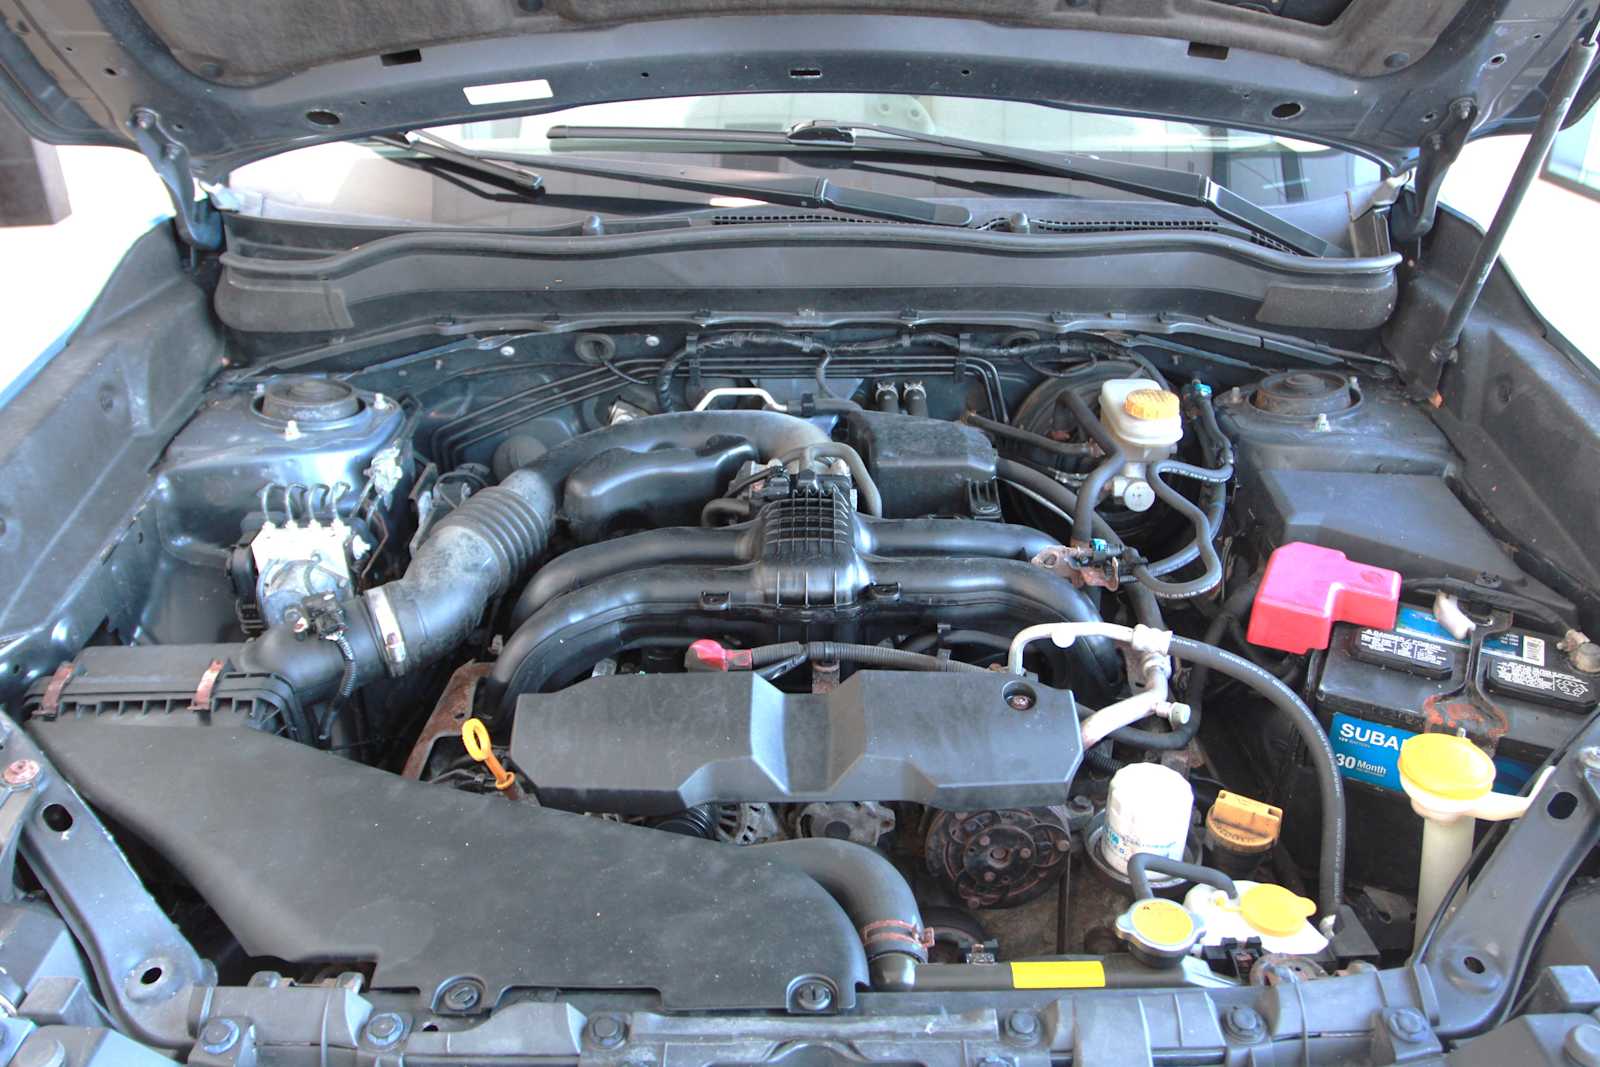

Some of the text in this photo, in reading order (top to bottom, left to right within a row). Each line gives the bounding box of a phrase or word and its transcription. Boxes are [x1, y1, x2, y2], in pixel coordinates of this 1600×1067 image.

[1340, 723, 1404, 751] SUBA
[1335, 753, 1356, 769] 30
[1357, 760, 1387, 775] Month
